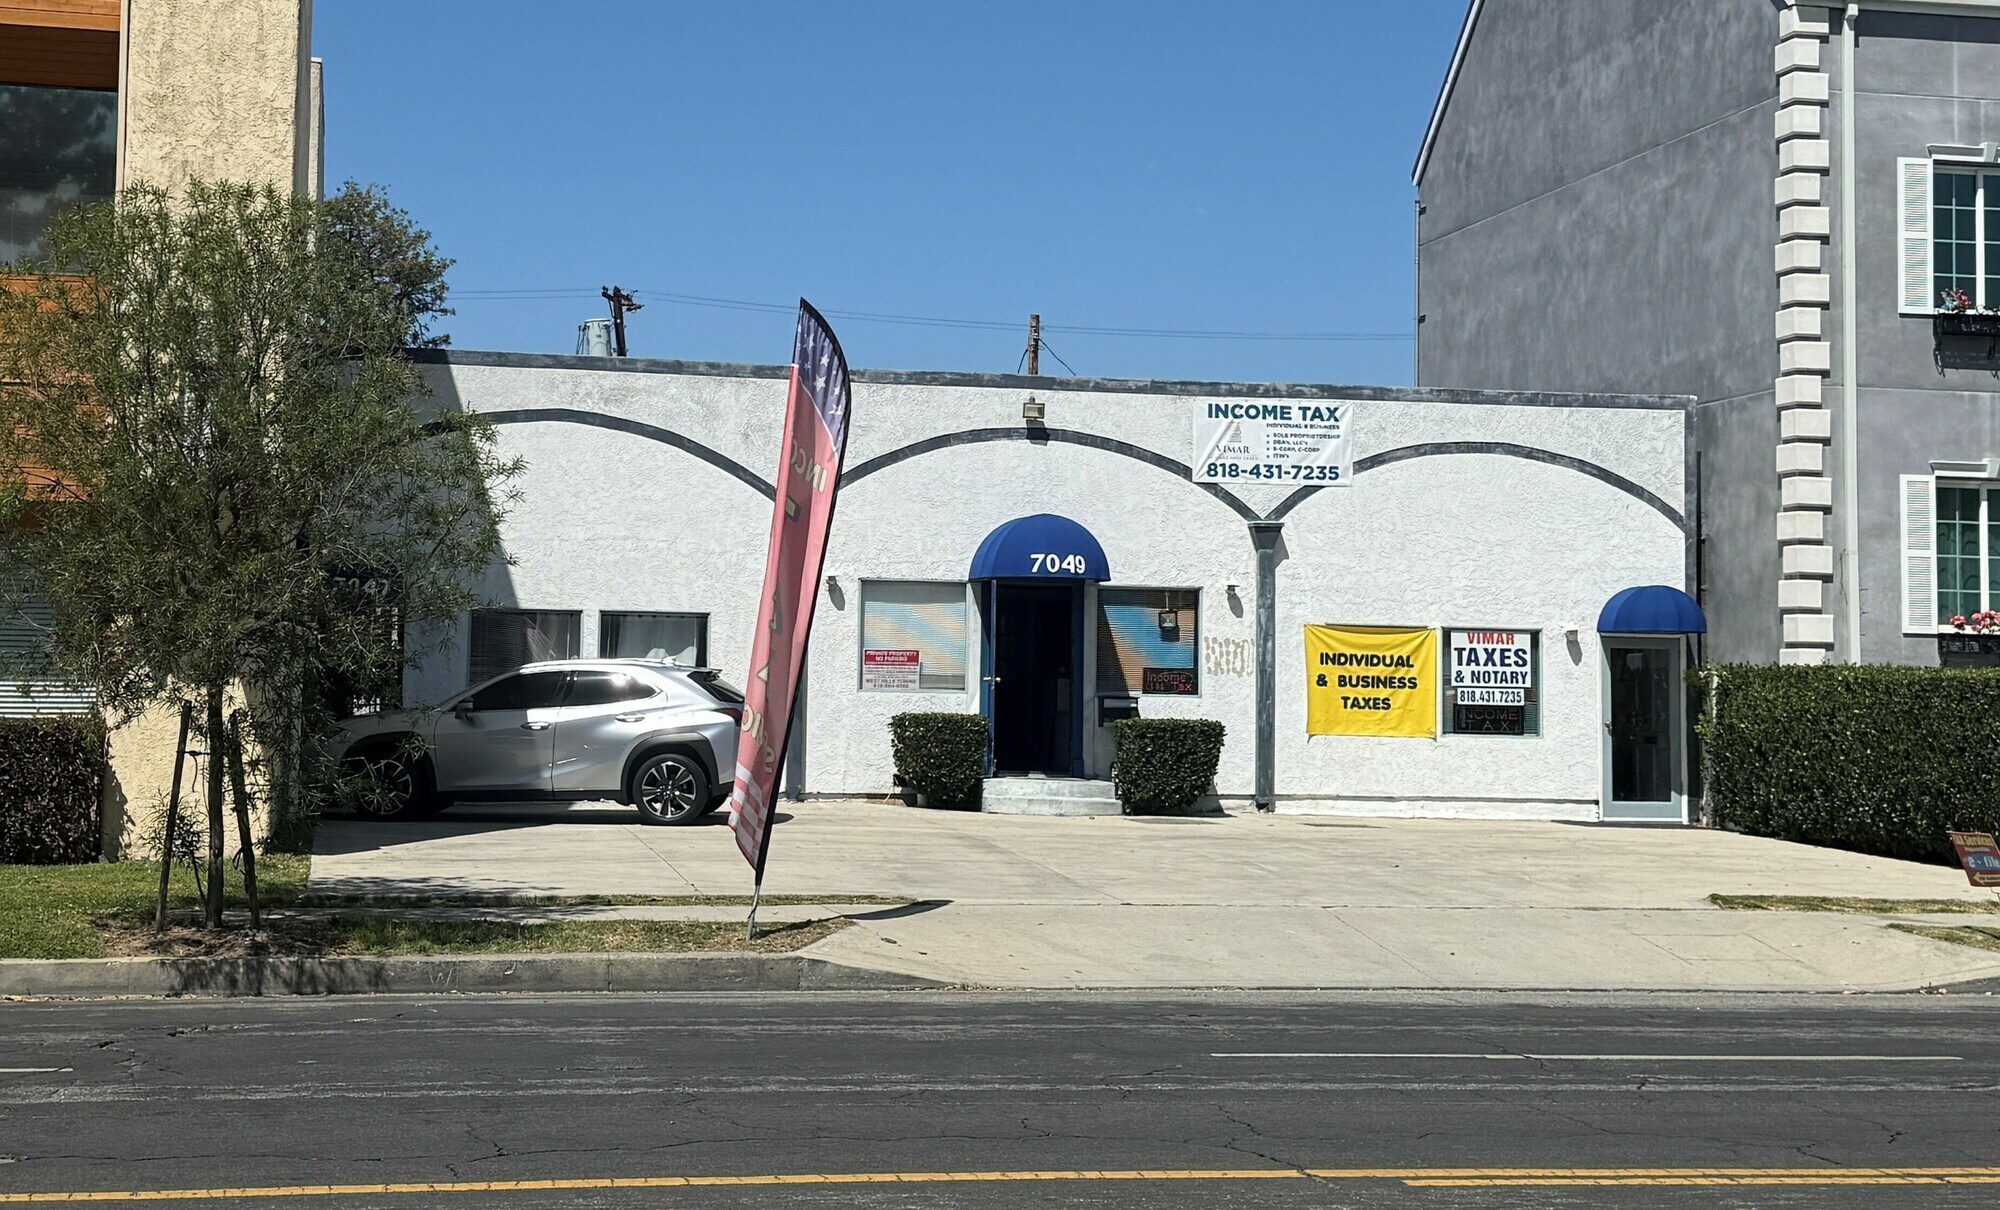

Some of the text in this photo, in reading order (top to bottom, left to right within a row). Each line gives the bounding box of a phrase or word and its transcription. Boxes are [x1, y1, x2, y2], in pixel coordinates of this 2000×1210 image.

[1207, 403, 1340, 422] INCOME TAX
[1216, 445, 1250, 455] VIMAR
[1206, 462, 1340, 481] 818-431-7235
[1030, 553, 1086, 574] 7049
[1466, 632, 1515, 645] VIMAR
[1319, 652, 1414, 669] INDIVIDUAL
[1453, 647, 1528, 668] TAXES
[1316, 674, 1418, 690] & BUSINESS
[1454, 670, 1529, 685] & NOTARY
[1340, 695, 1392, 711] TAXES
[1459, 689, 1522, 704] 818.431.7235
